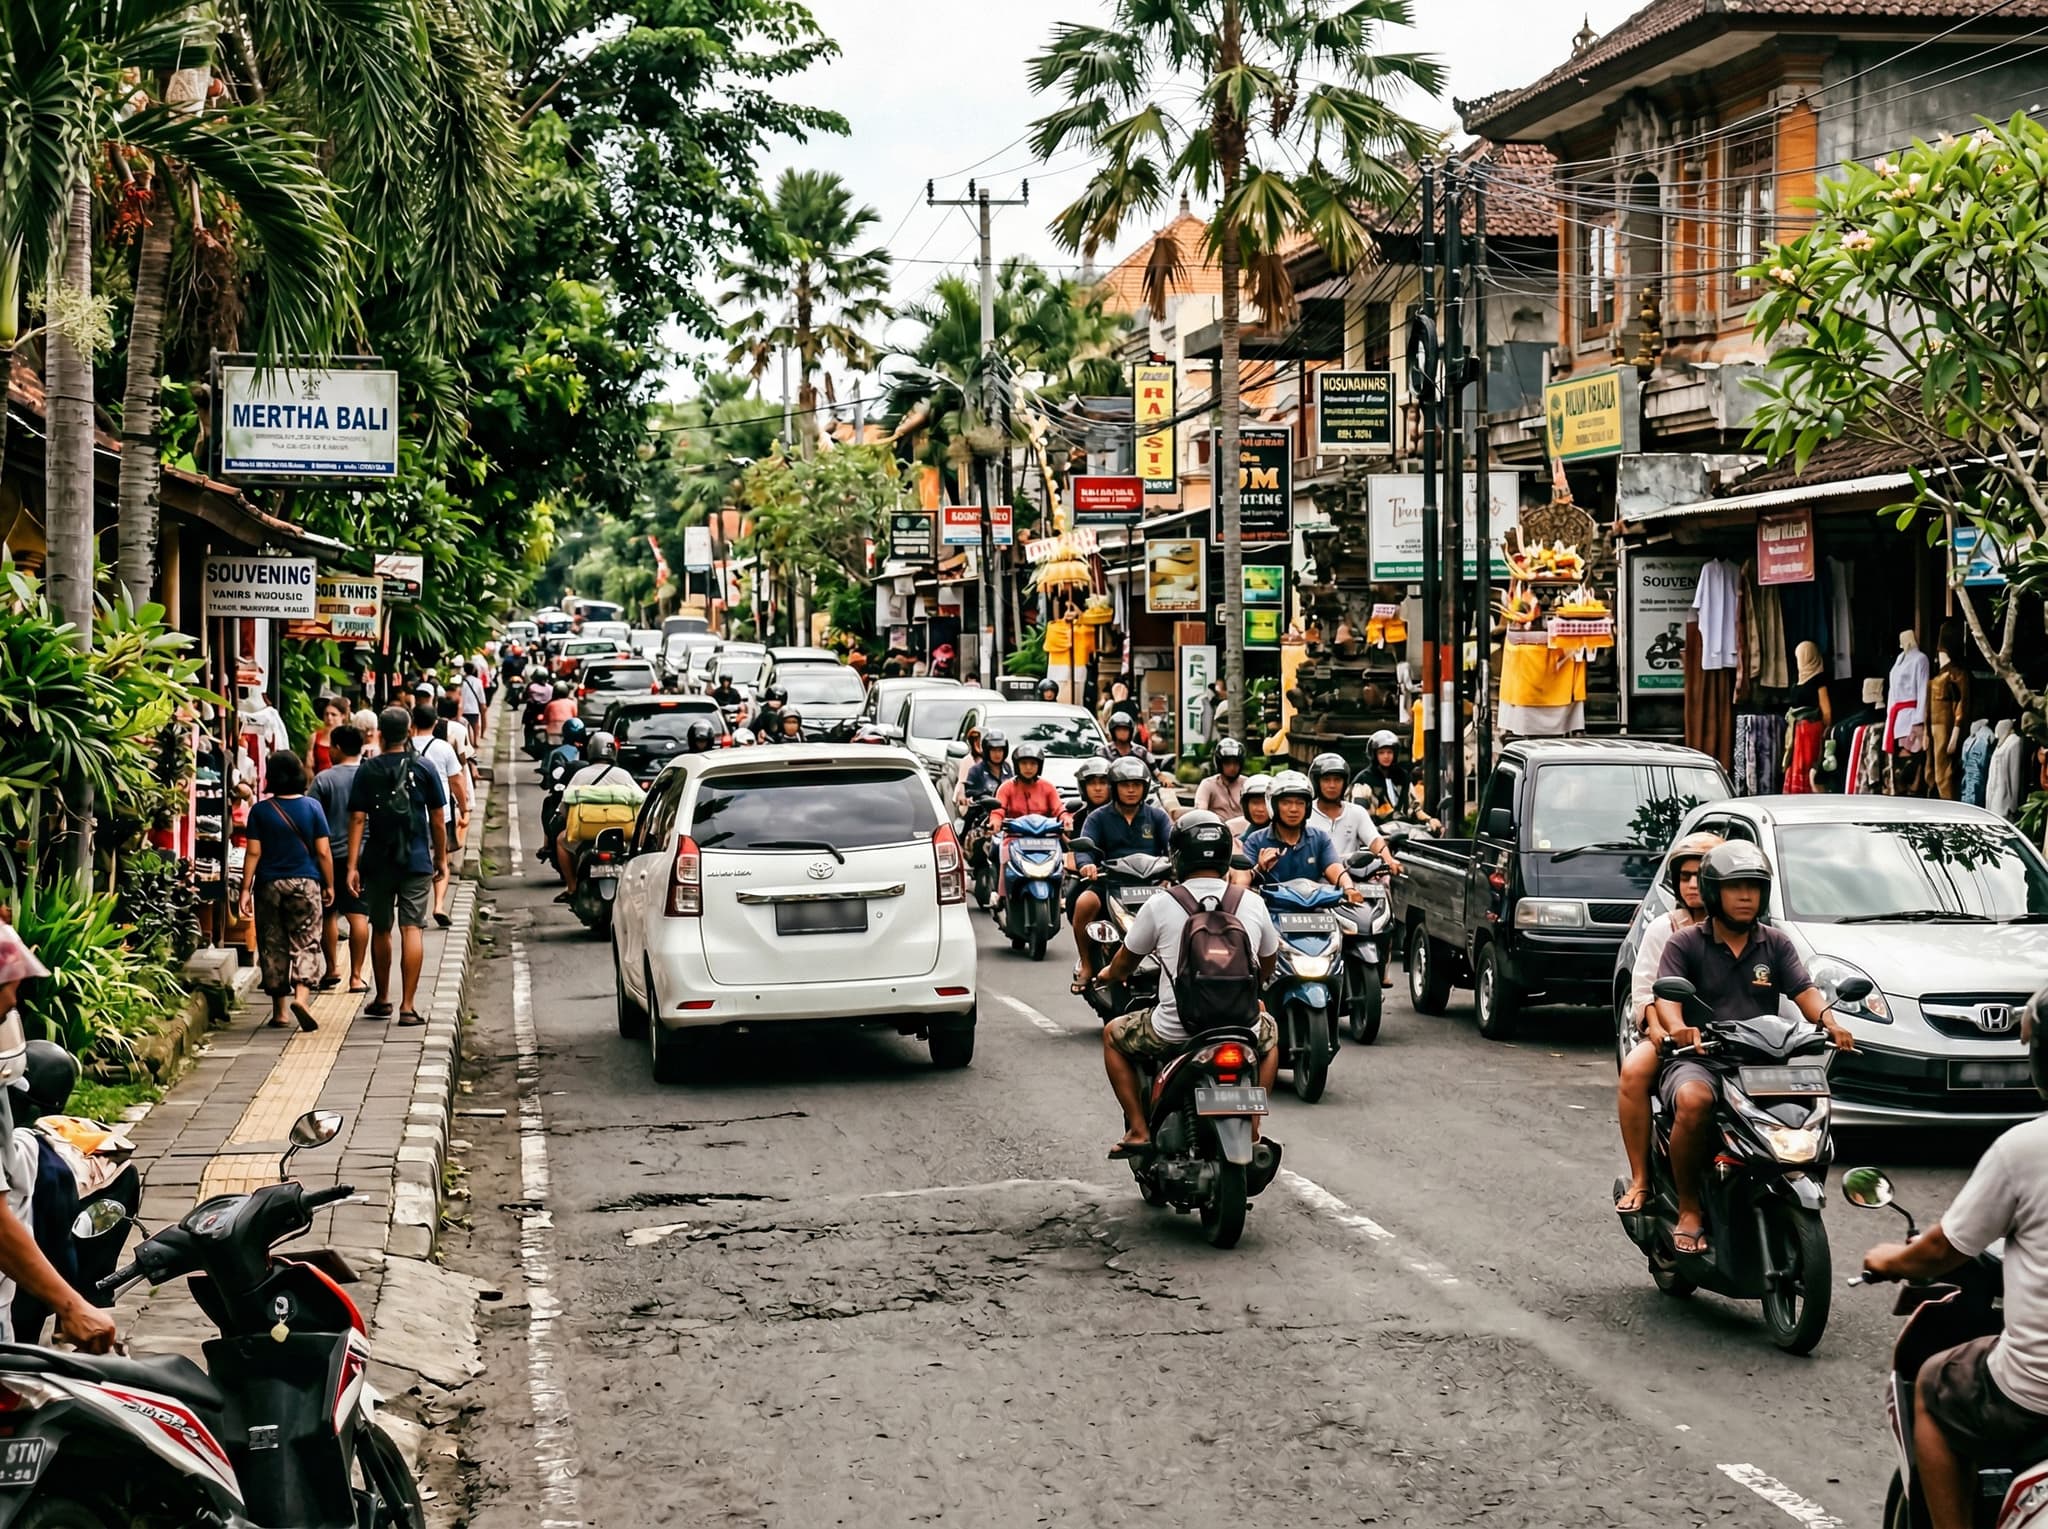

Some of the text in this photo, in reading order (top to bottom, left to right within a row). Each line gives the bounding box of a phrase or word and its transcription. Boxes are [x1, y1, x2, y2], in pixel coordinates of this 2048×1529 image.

[233, 404, 388, 431] MERTHA BALI
[6, 1443, 40, 1464] STN
